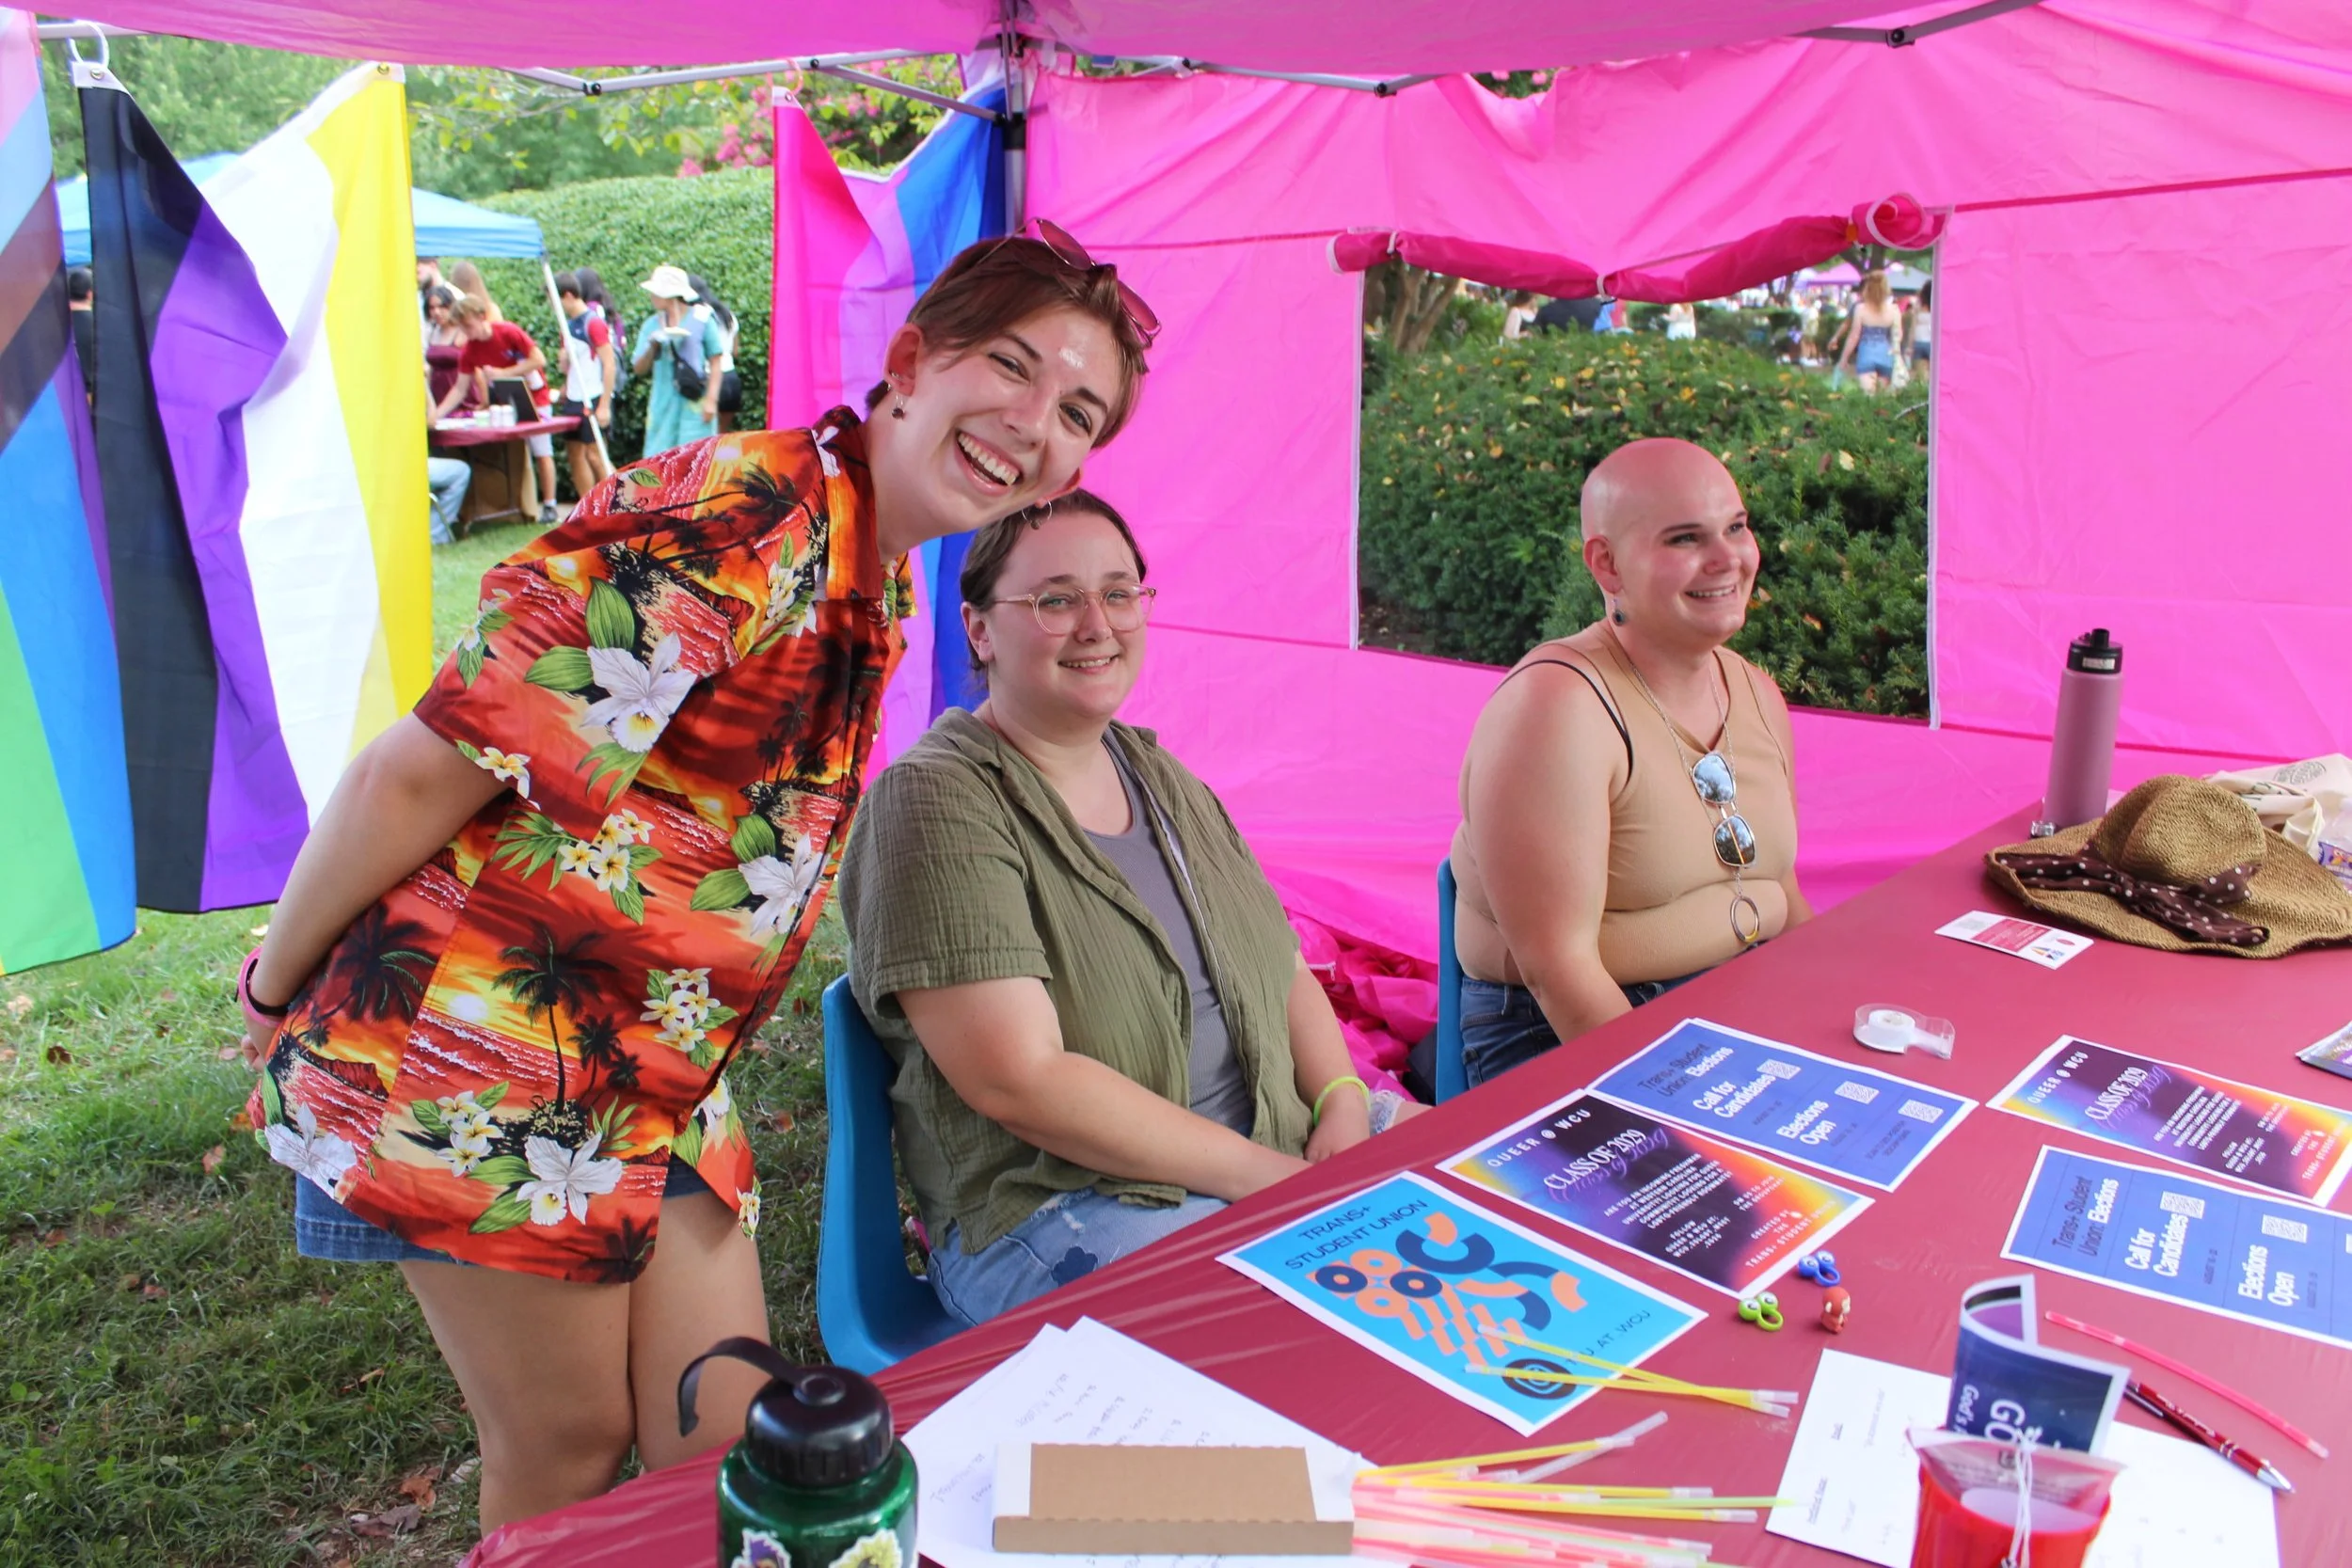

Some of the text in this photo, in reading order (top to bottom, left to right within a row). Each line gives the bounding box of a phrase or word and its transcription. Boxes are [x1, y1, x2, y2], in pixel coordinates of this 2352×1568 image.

[1669, 1043, 1710, 1069] Student
[1685, 1048, 1734, 1077] Elections
[1693, 1082, 1737, 1110] Call for
[1714, 1073, 1776, 1117] Candidates
[2026, 1078, 2060, 1104] QUEER
[2063, 1052, 2088, 1069] WCU
[2085, 1067, 2149, 1119] CLASS OF 2029
[1486, 1109, 1590, 1167] QUEER @ WCU
[1776, 1101, 1829, 1139] Elections
[1800, 1120, 1836, 1145] Open
[1543, 1129, 1646, 1189] CLASS OF 2029
[2052, 1176, 2092, 1248] Trans+ Student
[2088, 1179, 2119, 1224] Elections
[1285, 1200, 1428, 1269] STUDENT UNION
[1298, 1207, 1370, 1240] TRANS+
[1777, 1217, 1812, 1244] STUDENT
[2153, 1211, 2192, 1276] Candidates
[2125, 1228, 2155, 1270] Call for
[2238, 1245, 2268, 1300] Elections
[2267, 1272, 2299, 1307] Open
[1955, 1384, 1979, 1426] God's
